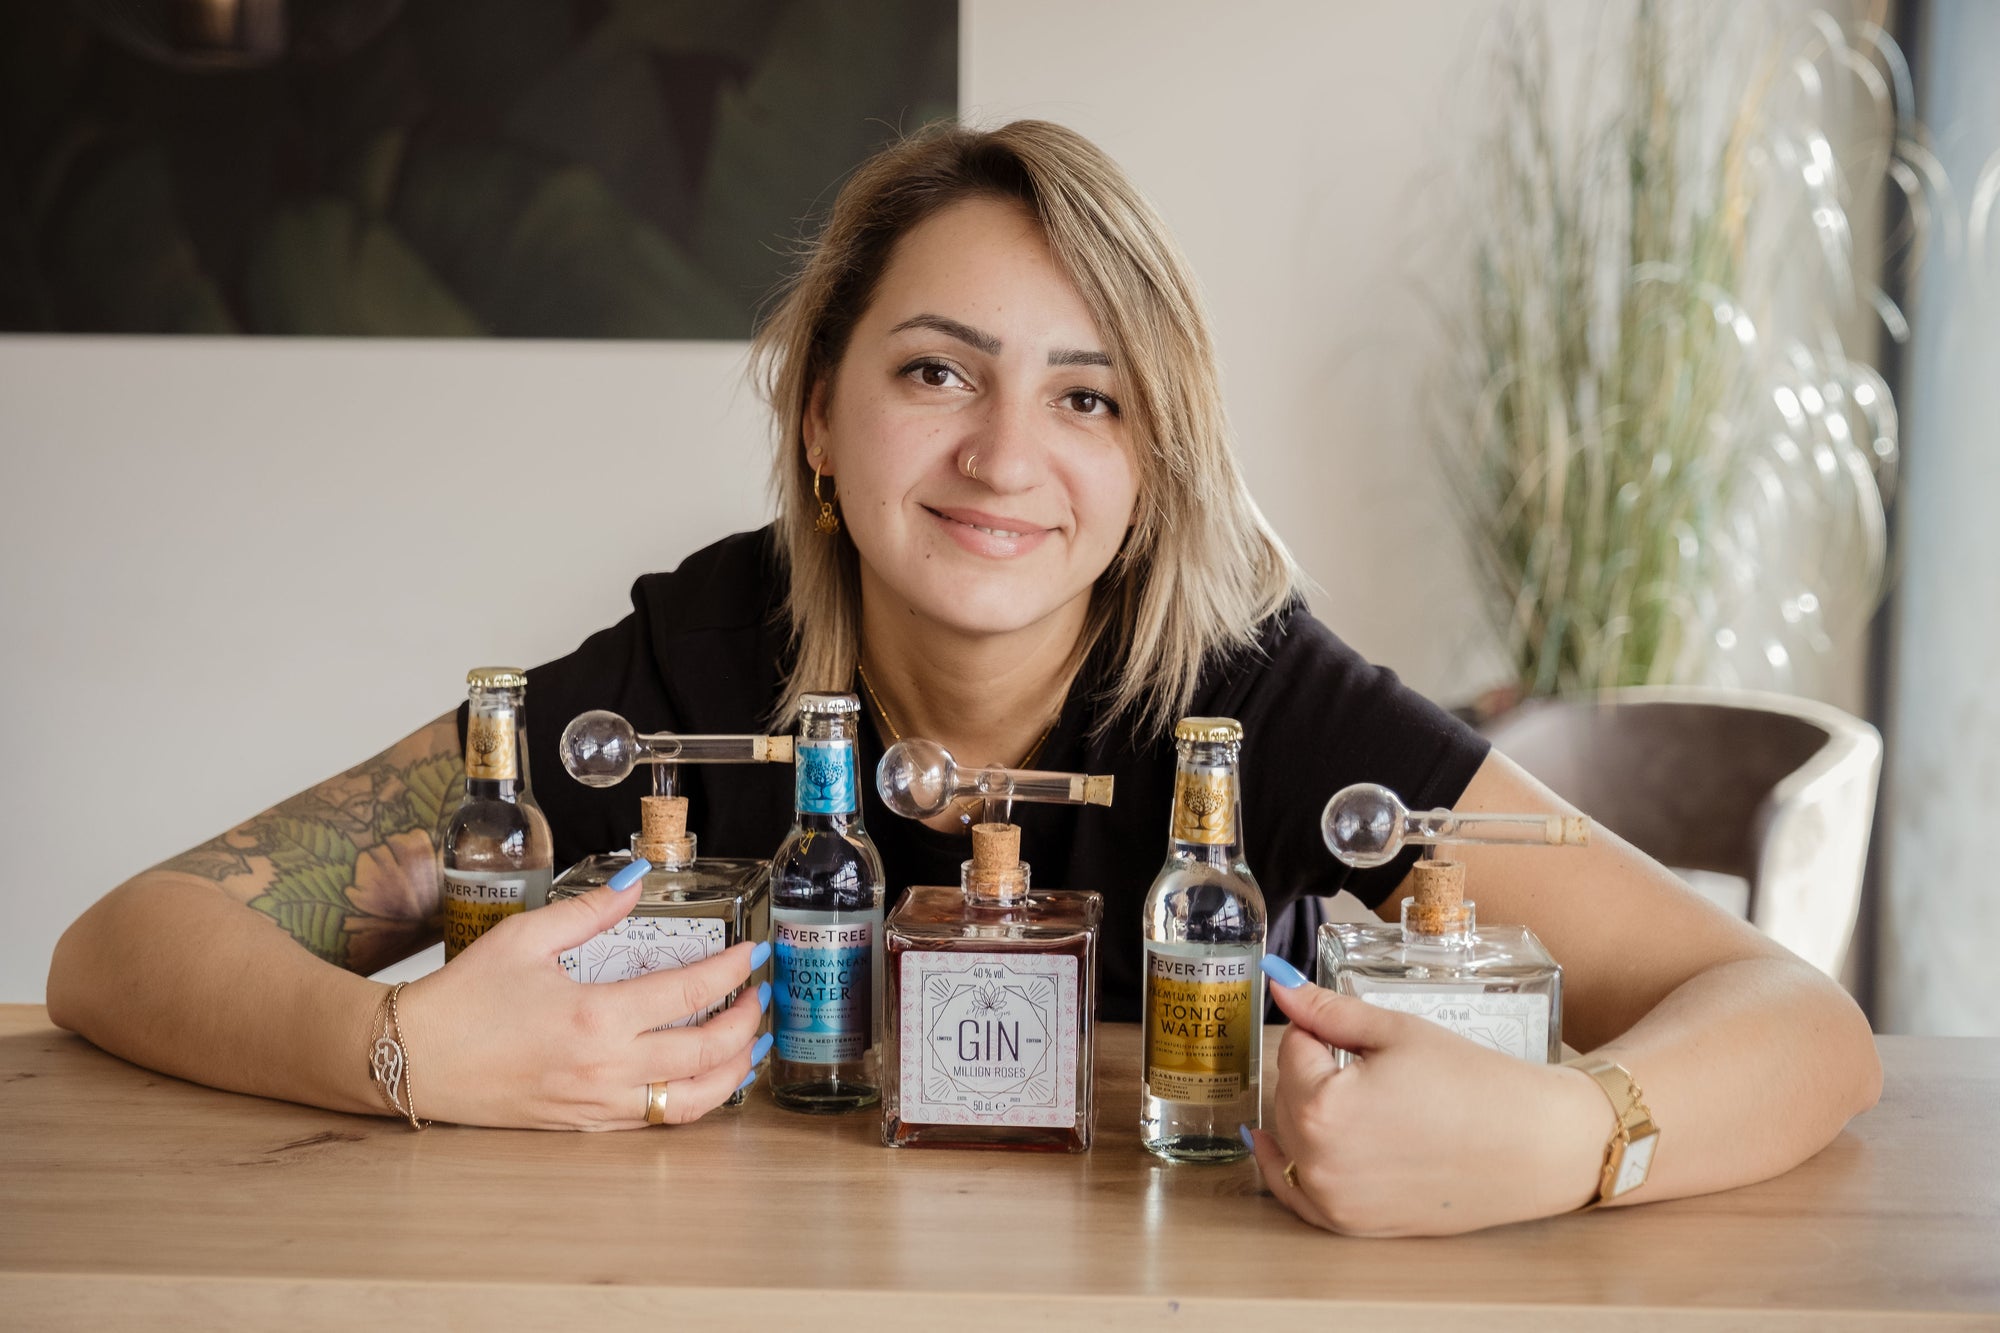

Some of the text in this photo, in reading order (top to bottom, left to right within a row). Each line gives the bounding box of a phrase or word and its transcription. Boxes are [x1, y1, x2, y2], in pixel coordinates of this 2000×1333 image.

[478, 911, 511, 922] INDI
[626, 929, 637, 941] 40
[638, 930, 645, 941] %
[777, 925, 866, 943] FEVER-TREE
[973, 967, 1006, 979] 40 % vol.
[1150, 955, 1246, 977] FEVER-TREE
[789, 970, 849, 985] TONIC
[788, 985, 851, 1001] WATER
[1203, 991, 1248, 1003] INDIAN
[1163, 1003, 1226, 1021] TONIC
[1437, 1009, 1448, 1021] 40
[1449, 1009, 1458, 1021] %
[1160, 1019, 1229, 1038] WATER
[958, 1019, 1019, 1062] GIN
[953, 1065, 1026, 1079] MILLION ROSES
[973, 1100, 983, 1112] 50
